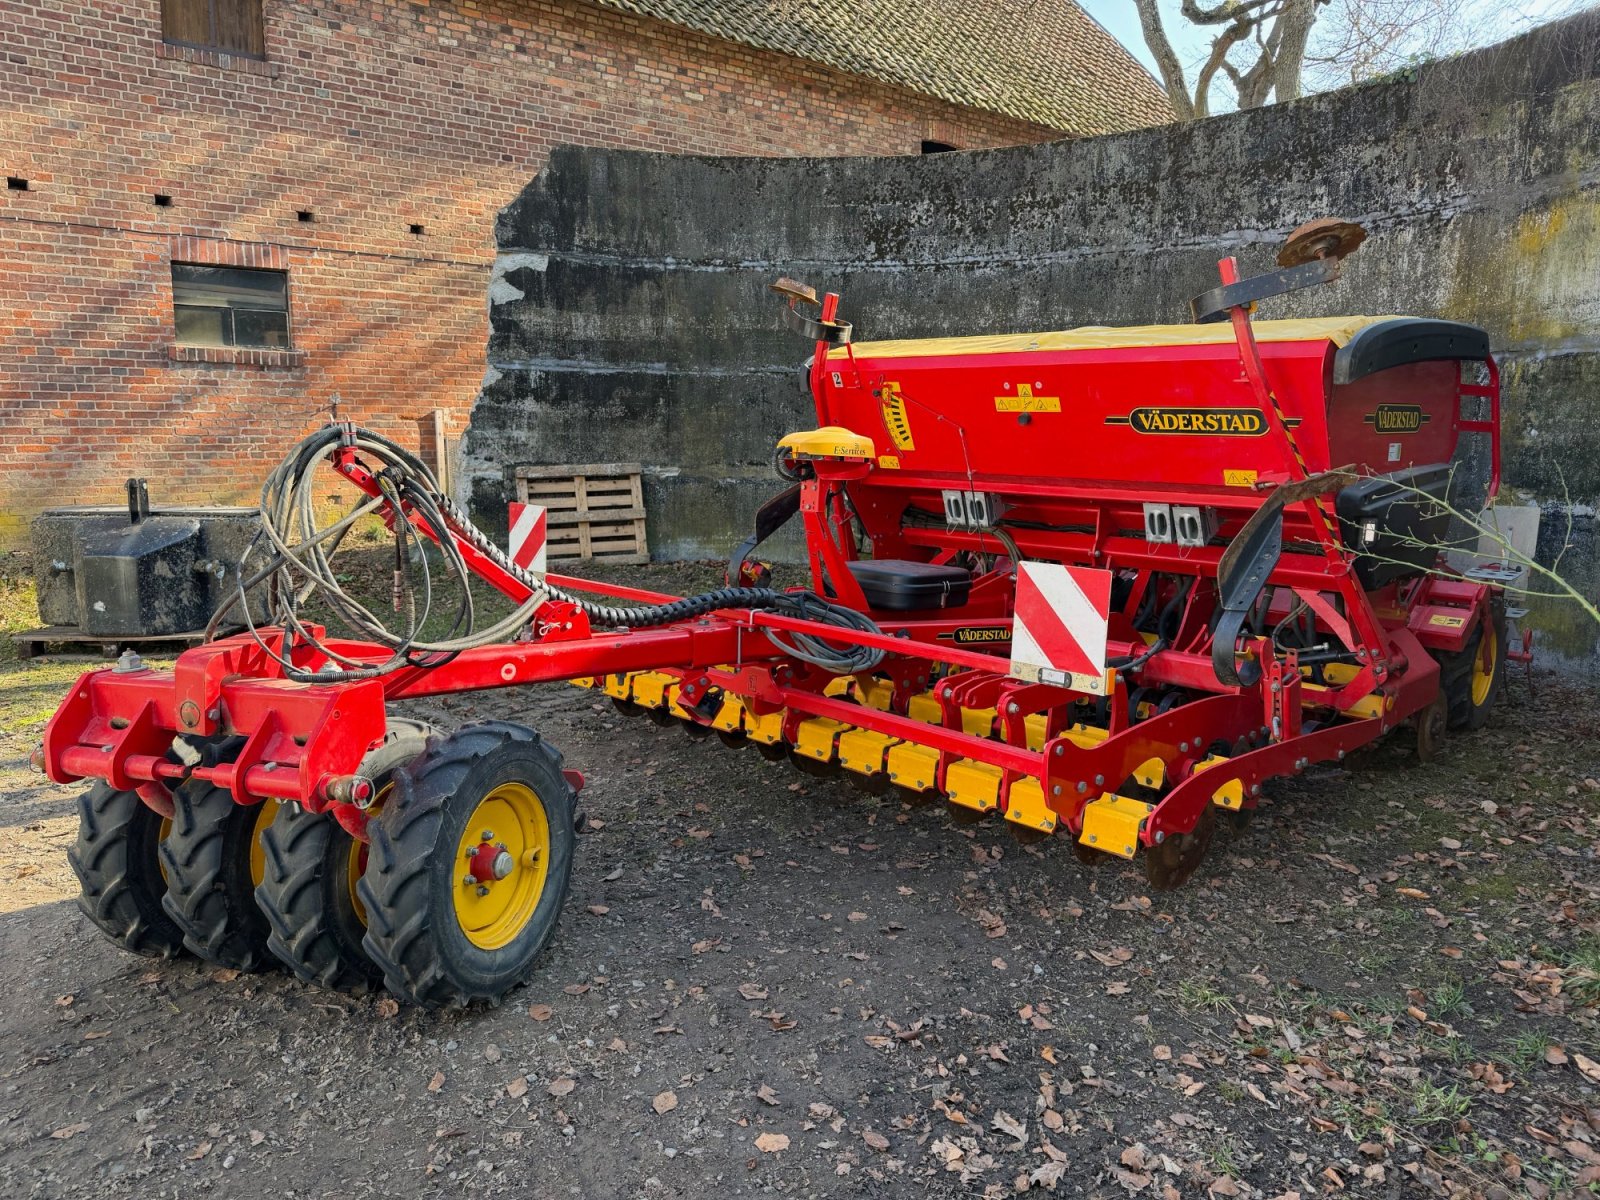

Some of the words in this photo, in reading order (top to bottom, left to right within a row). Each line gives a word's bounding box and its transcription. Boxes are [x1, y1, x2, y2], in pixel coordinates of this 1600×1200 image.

[833, 373, 841, 384] 2
[1138, 410, 1260, 431] VÄDERSTAD
[1378, 406, 1419, 428] VÄDERSTAD
[959, 628, 1011, 640] VÄDERSTAD
